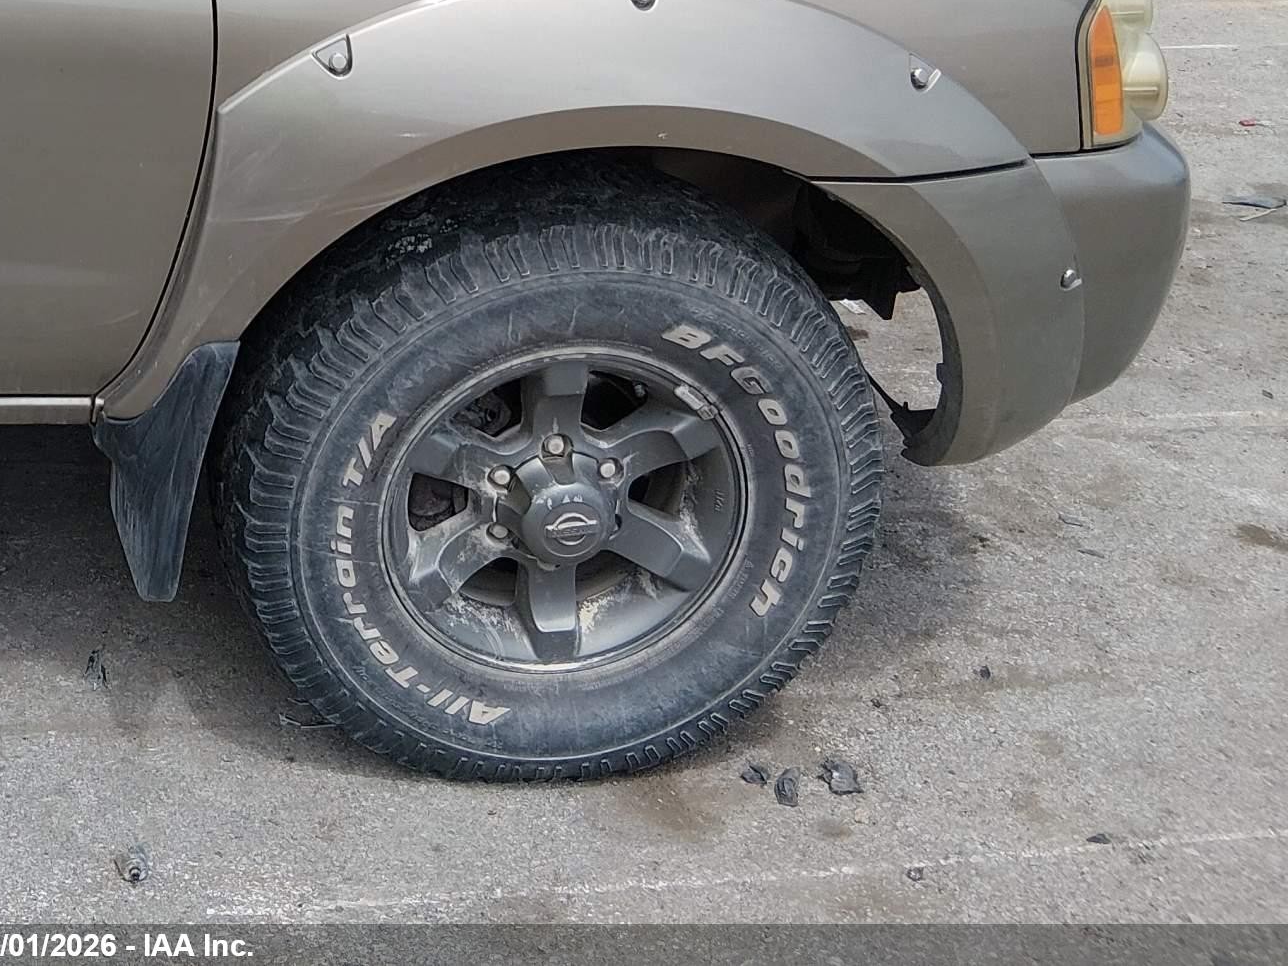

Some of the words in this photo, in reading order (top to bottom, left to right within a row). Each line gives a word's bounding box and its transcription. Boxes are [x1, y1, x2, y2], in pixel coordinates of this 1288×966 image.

[341, 411, 398, 488] T/A
[662, 323, 812, 617] BFGoodrich
[333, 504, 511, 725] All-Terrain
